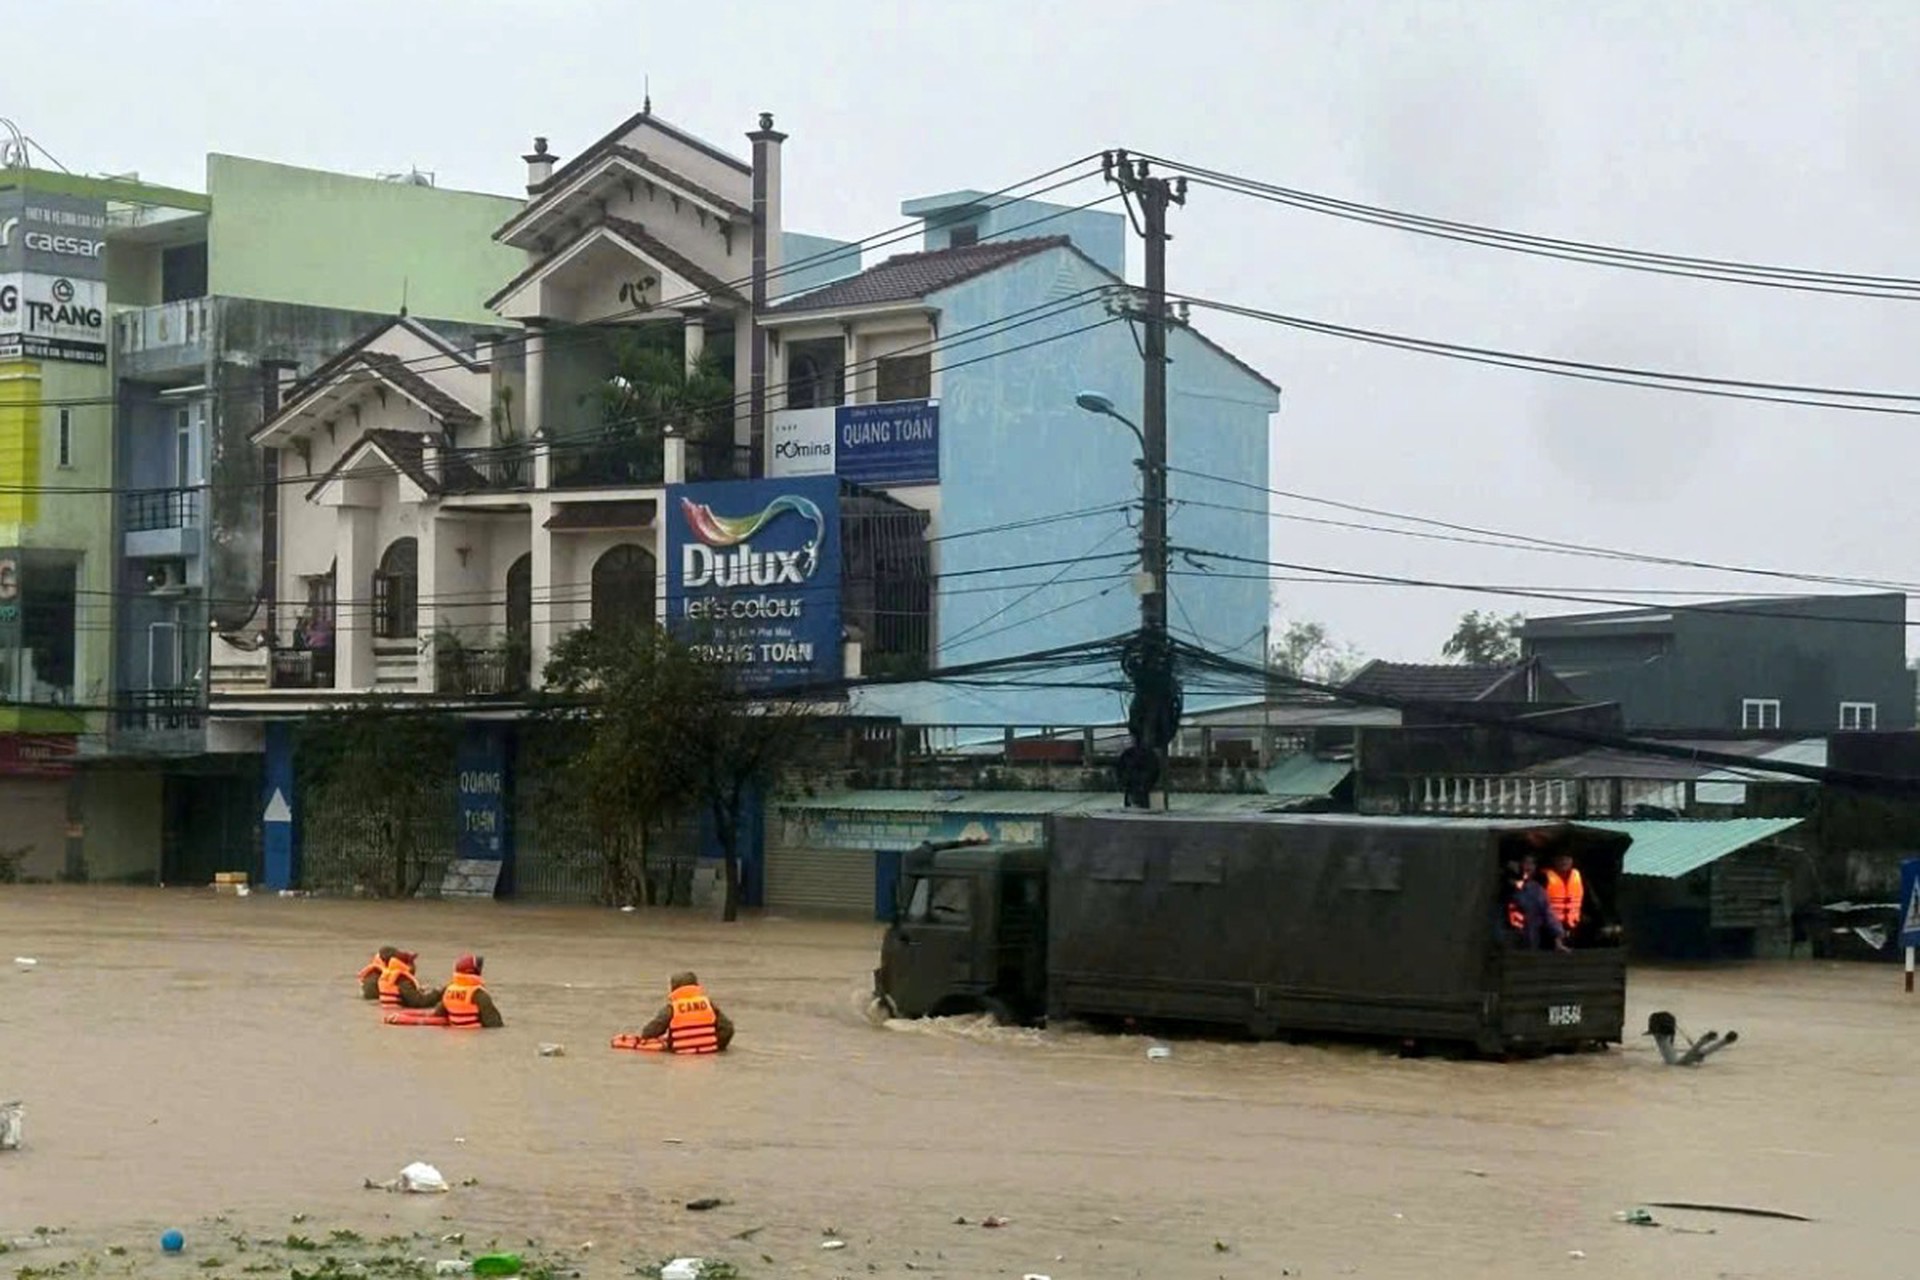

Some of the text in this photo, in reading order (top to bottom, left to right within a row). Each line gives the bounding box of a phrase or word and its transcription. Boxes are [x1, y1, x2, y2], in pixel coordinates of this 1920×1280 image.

[25, 232, 107, 257] caesar
[25, 300, 103, 331] TRANG
[842, 422, 890, 447] QUANG
[682, 542, 804, 587] Dulux
[731, 595, 804, 619] colour
